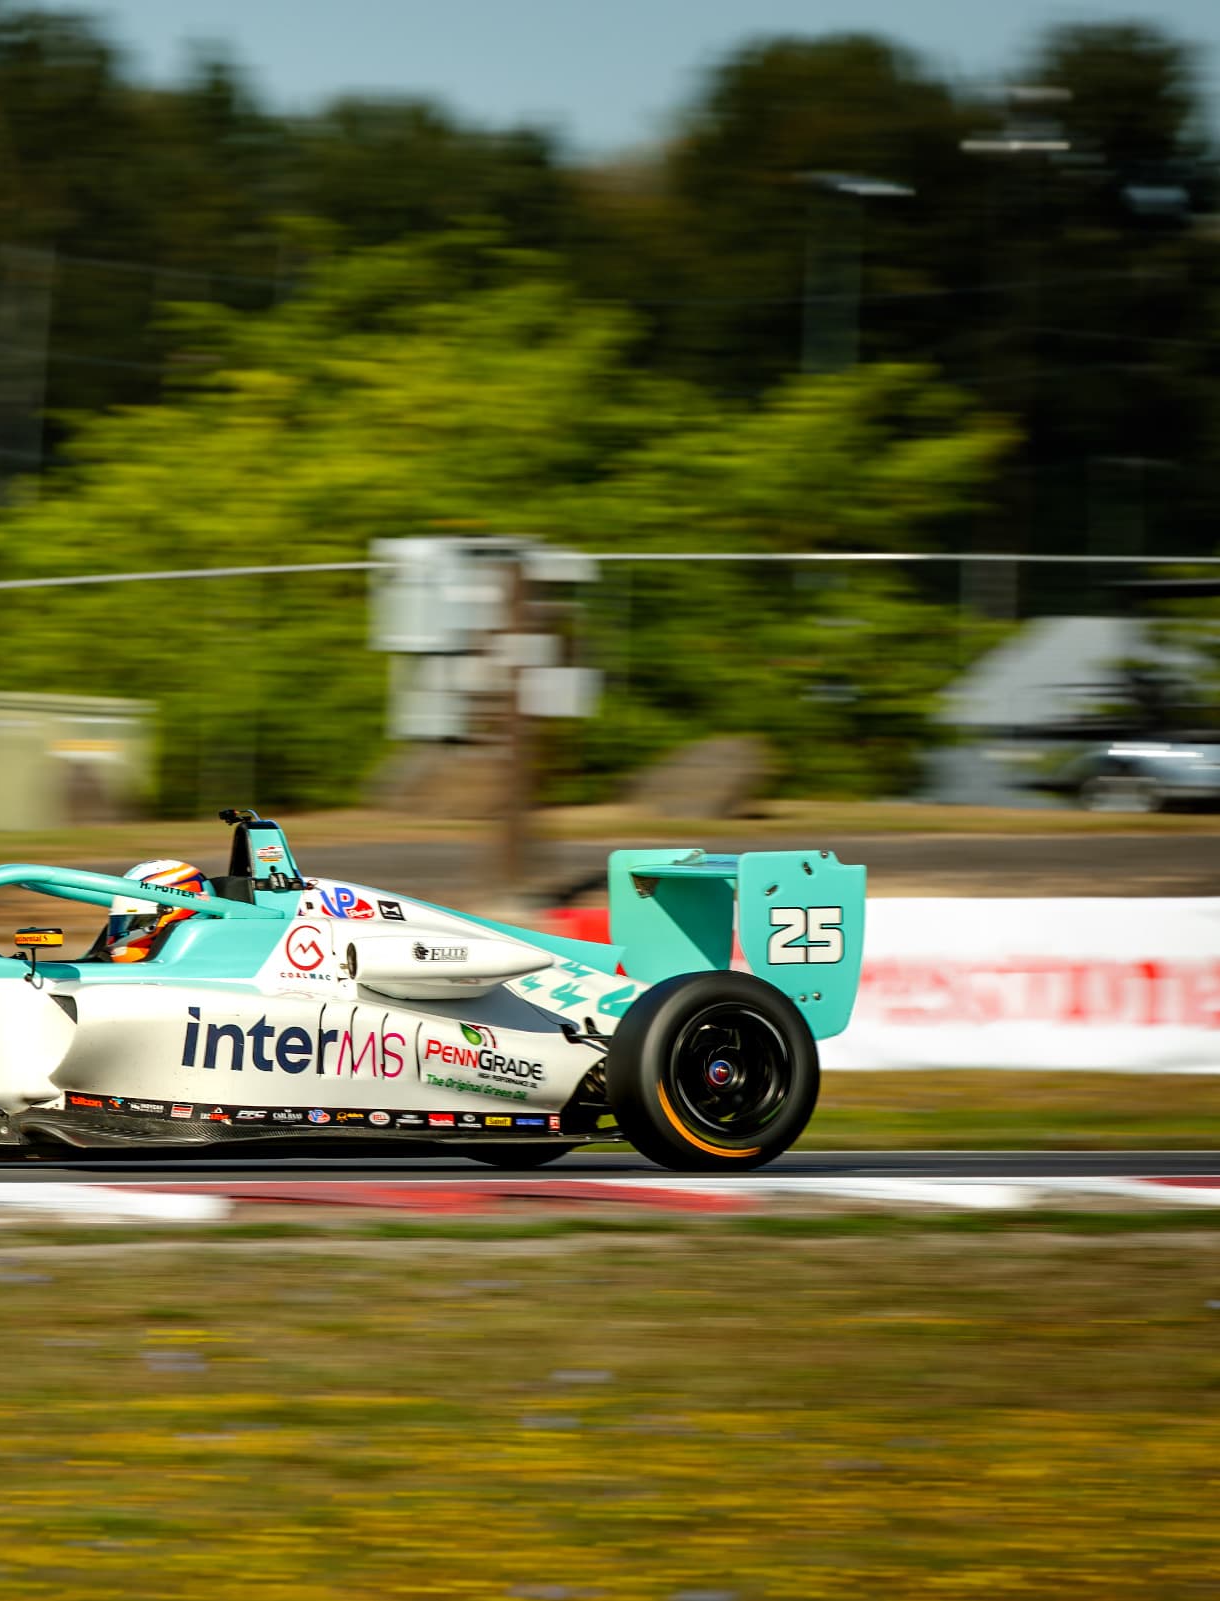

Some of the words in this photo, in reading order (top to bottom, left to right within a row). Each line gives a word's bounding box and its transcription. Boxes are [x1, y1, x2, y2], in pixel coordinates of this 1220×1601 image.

[154, 884, 195, 899] POTTER
[320, 887, 355, 919] VP
[767, 906, 844, 965] 25
[279, 971, 332, 981] COALMAC
[181, 1006, 406, 1078] interMS
[426, 1073, 444, 1087] The
[445, 1078, 482, 1092] Original
[483, 1085, 512, 1097] Green
